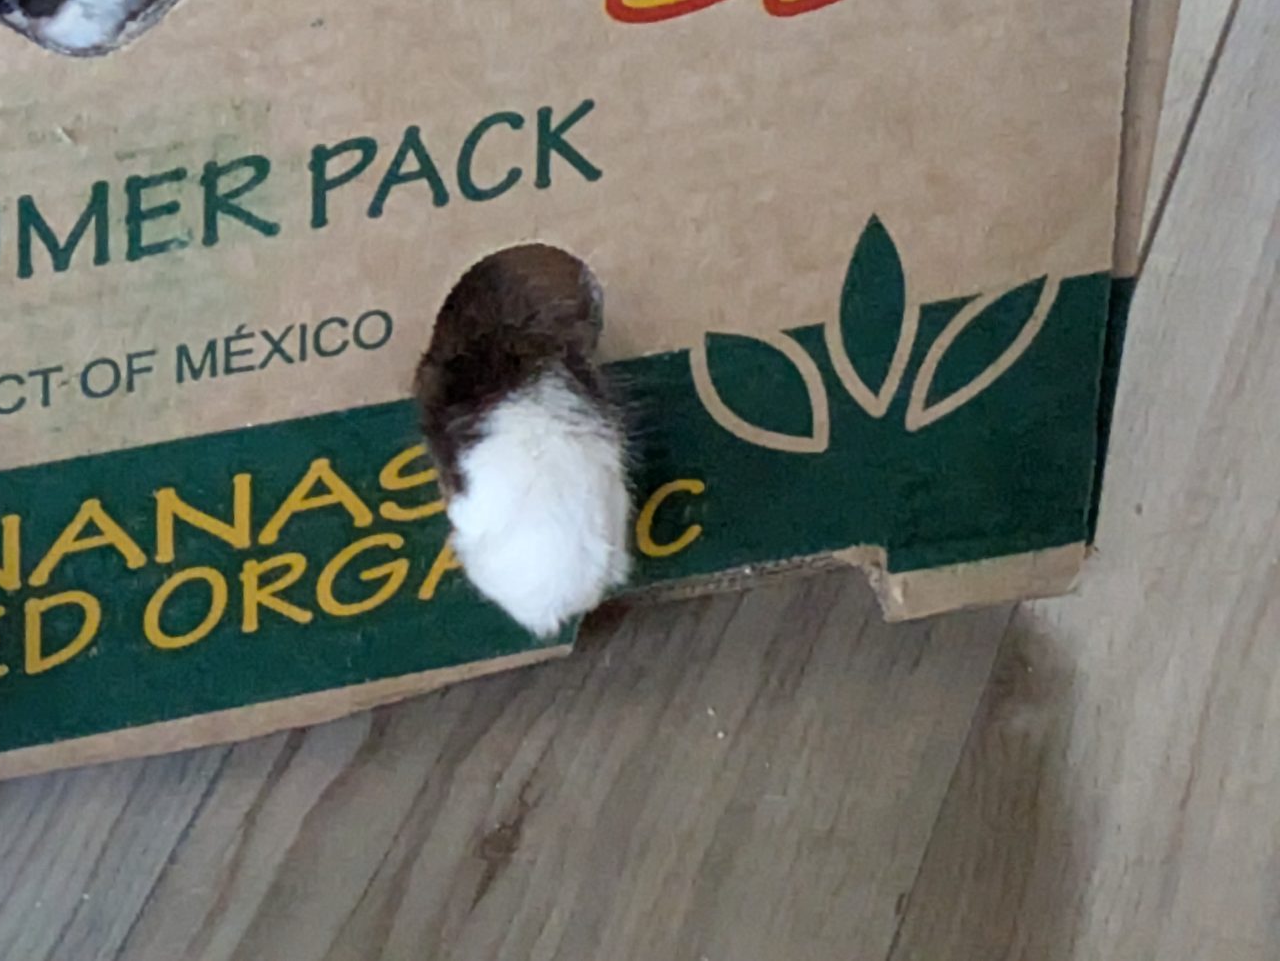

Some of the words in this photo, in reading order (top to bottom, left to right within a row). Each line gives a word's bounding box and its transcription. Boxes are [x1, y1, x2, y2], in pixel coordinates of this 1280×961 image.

[307, 98, 604, 231] PACK
[79, 348, 159, 399] OF
[175, 309, 394, 385] MÉXICO
[142, 478, 706, 651] ORGC
